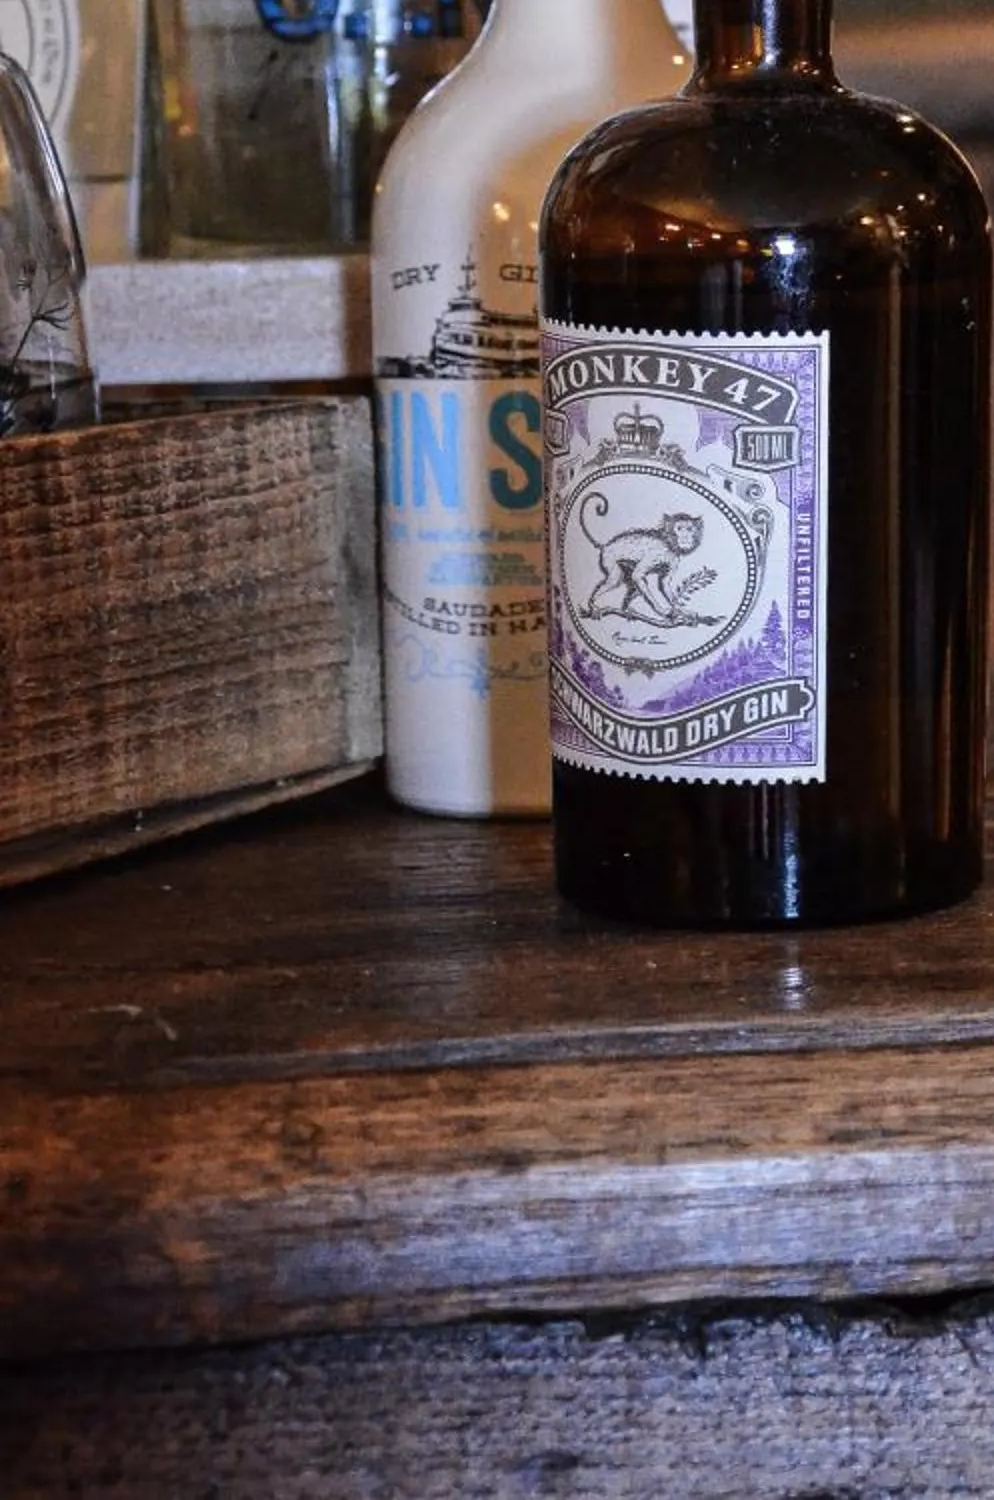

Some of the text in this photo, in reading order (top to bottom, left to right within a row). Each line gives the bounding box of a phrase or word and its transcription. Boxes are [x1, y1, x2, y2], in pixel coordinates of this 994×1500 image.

[391, 262, 440, 290] DRY
[549, 354, 782, 412] MONKEY 47
[796, 512, 811, 620] UNFILTERED
[686, 703, 737, 746] DRY
[744, 689, 789, 719] GIN
